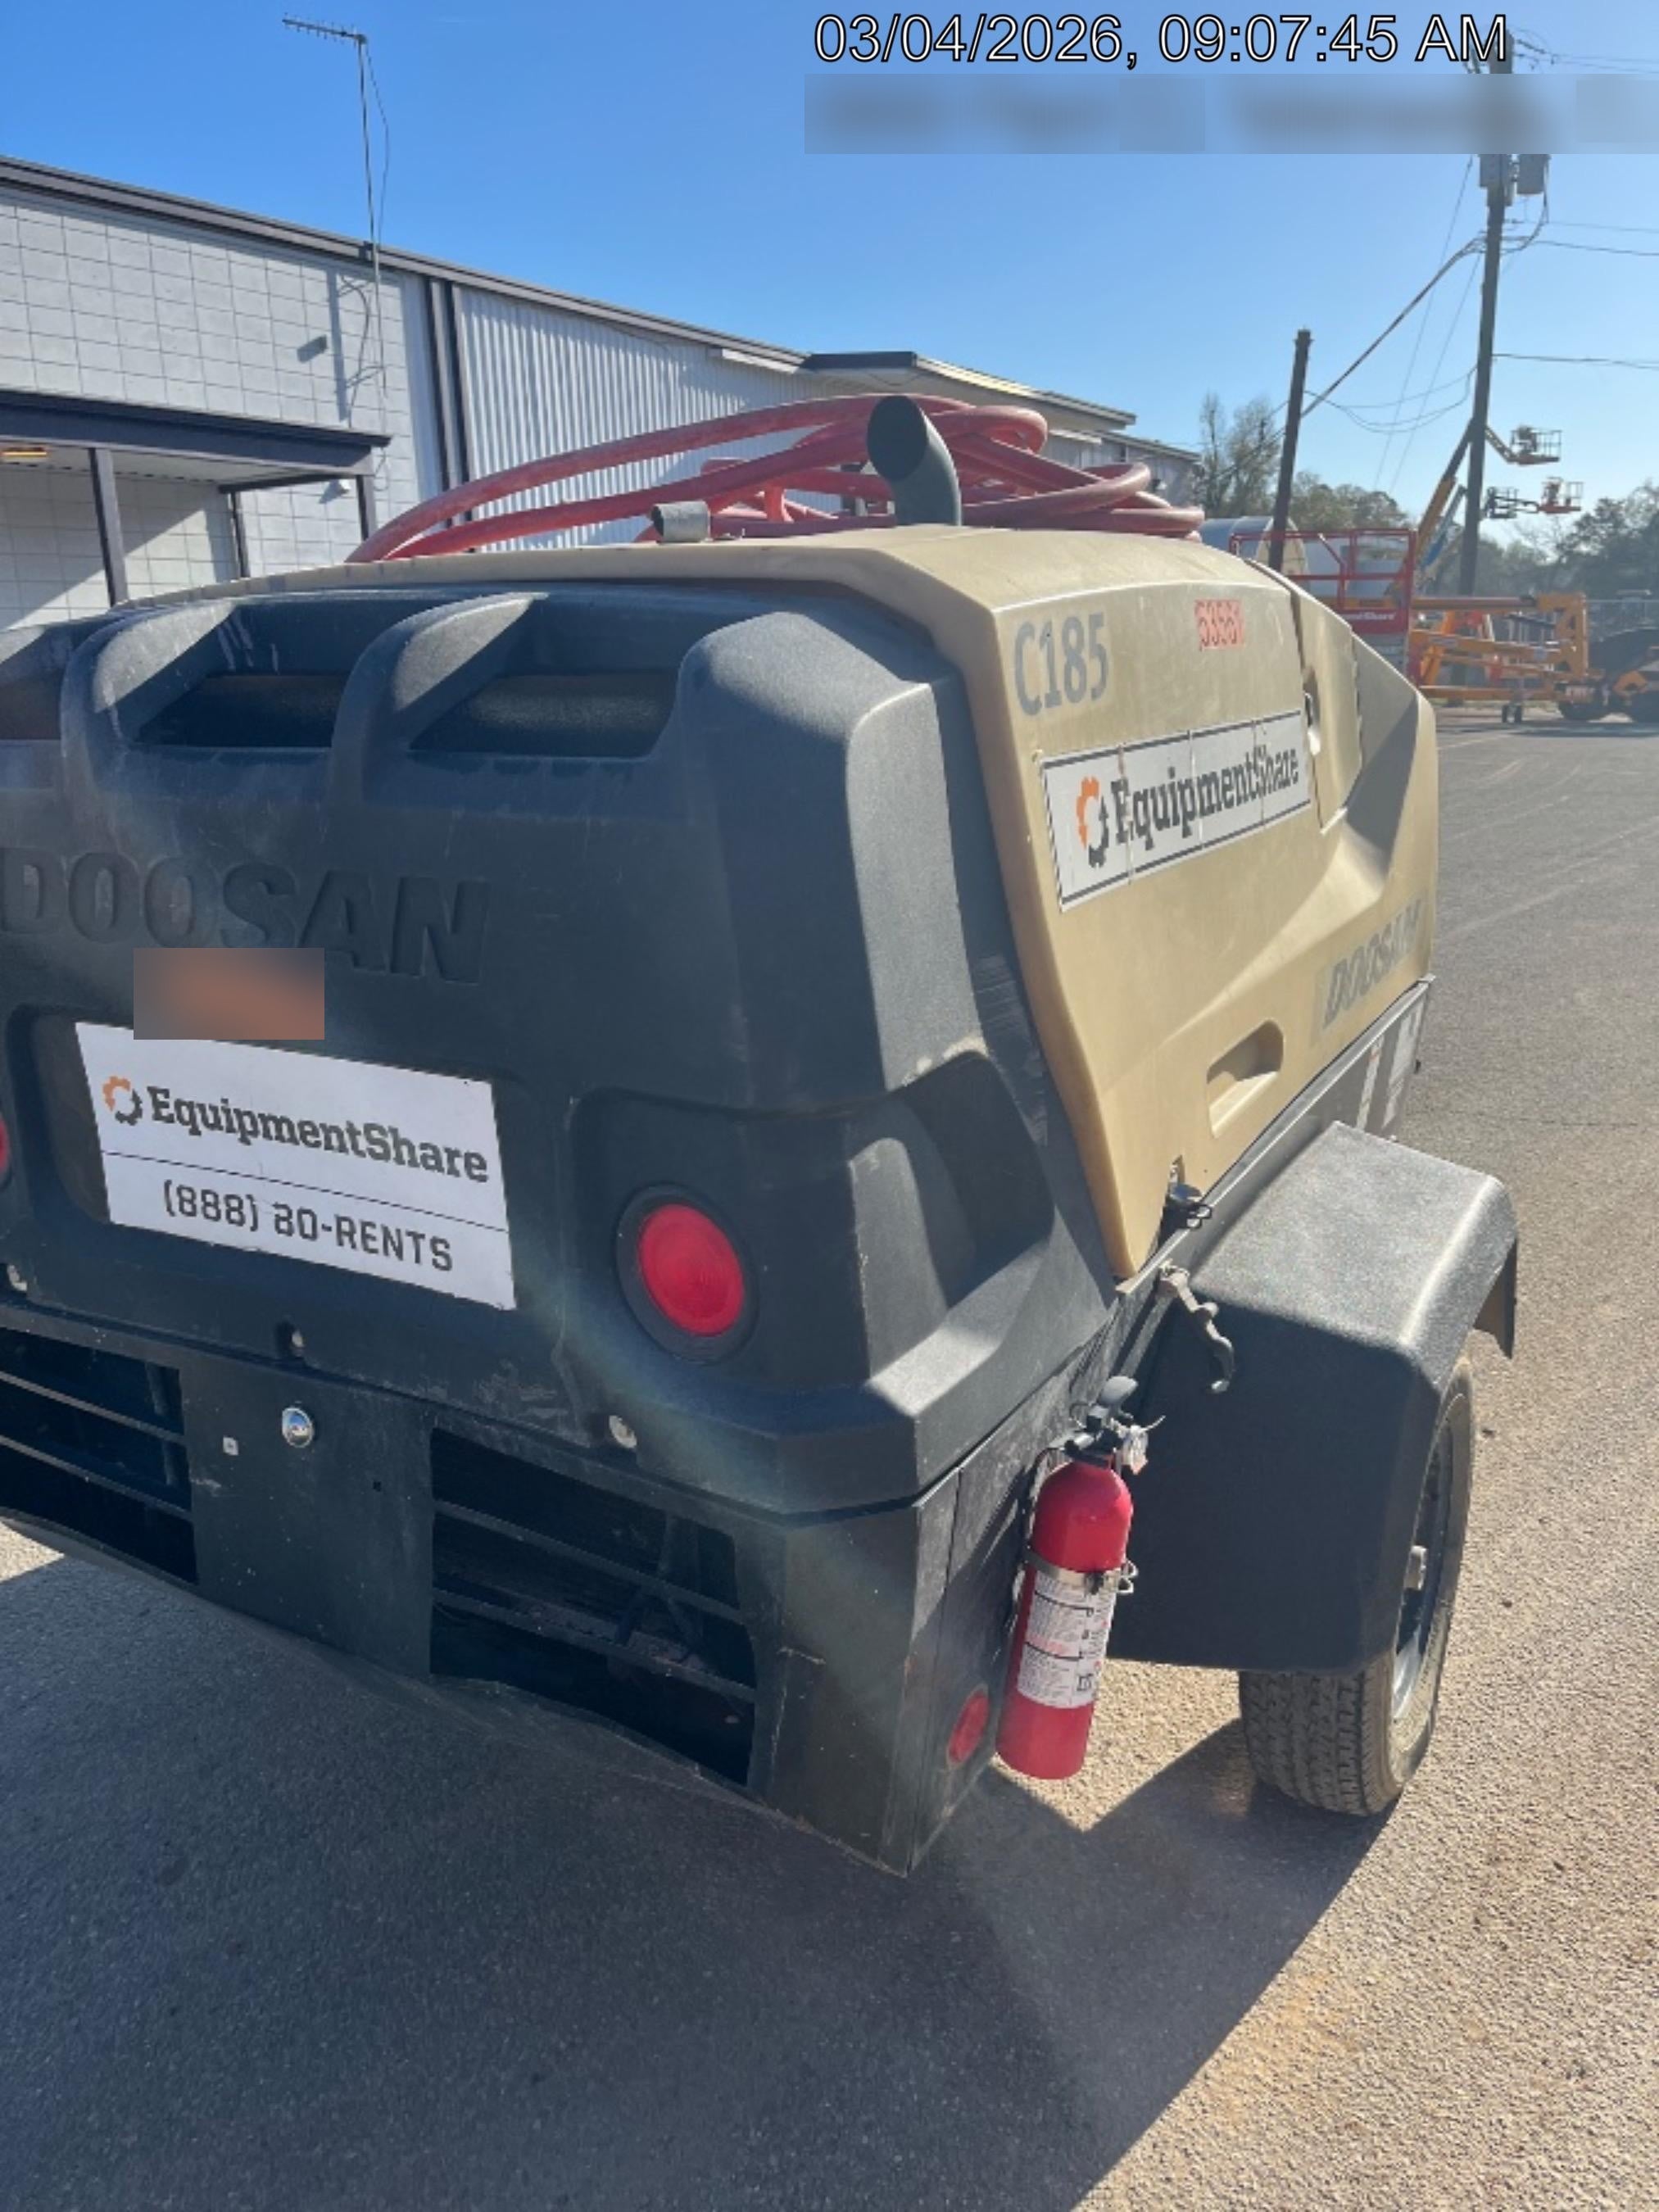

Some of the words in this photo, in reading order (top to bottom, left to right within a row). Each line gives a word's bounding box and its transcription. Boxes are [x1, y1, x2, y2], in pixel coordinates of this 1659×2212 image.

[1015, 611, 1107, 716] C185
[1111, 744, 1299, 850] EquipmentShare
[0, 847, 490, 985] DOOSAN
[147, 1086, 488, 1183] EquipmentShare
[164, 1180, 259, 1231] (888)
